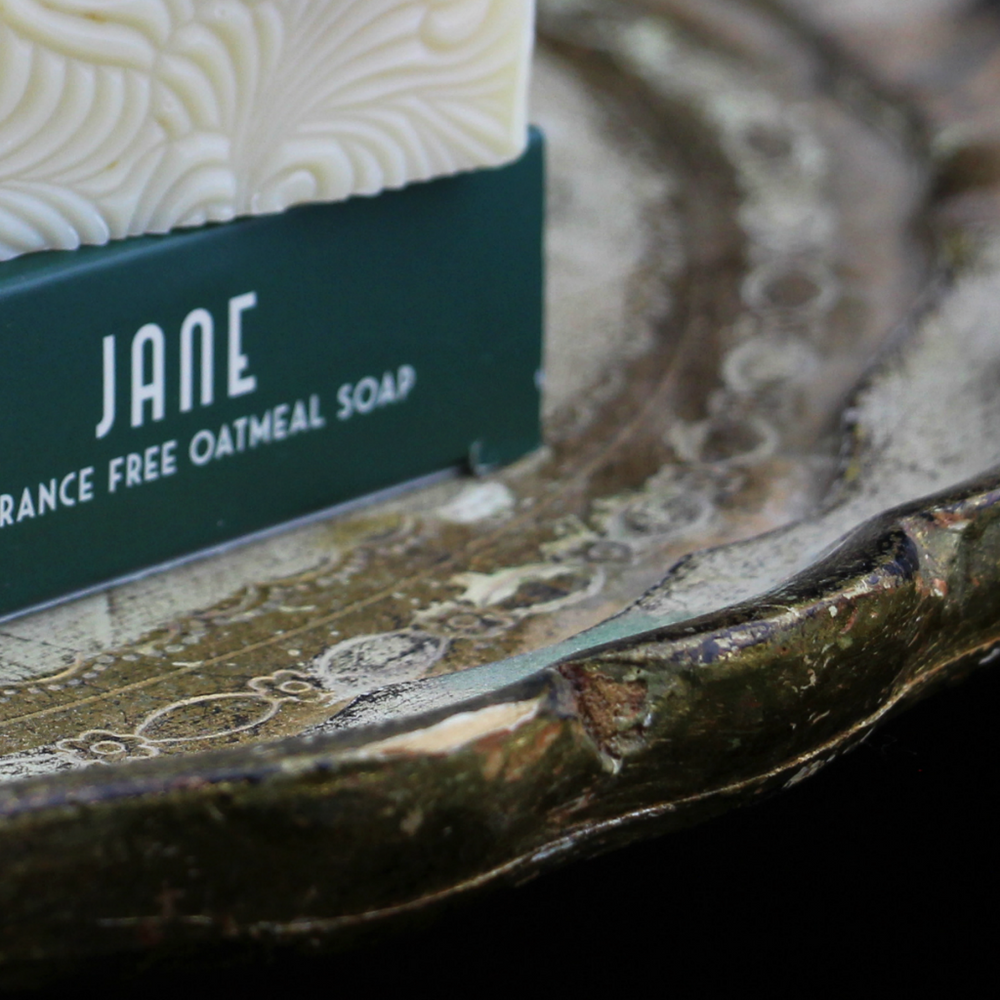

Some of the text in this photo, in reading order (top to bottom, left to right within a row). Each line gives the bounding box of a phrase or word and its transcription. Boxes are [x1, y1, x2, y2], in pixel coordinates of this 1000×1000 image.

[95, 291, 257, 439] JANE
[107, 440, 178, 493] FREE
[188, 395, 326, 466] OATMEAL
[336, 364, 416, 422] SOAP
